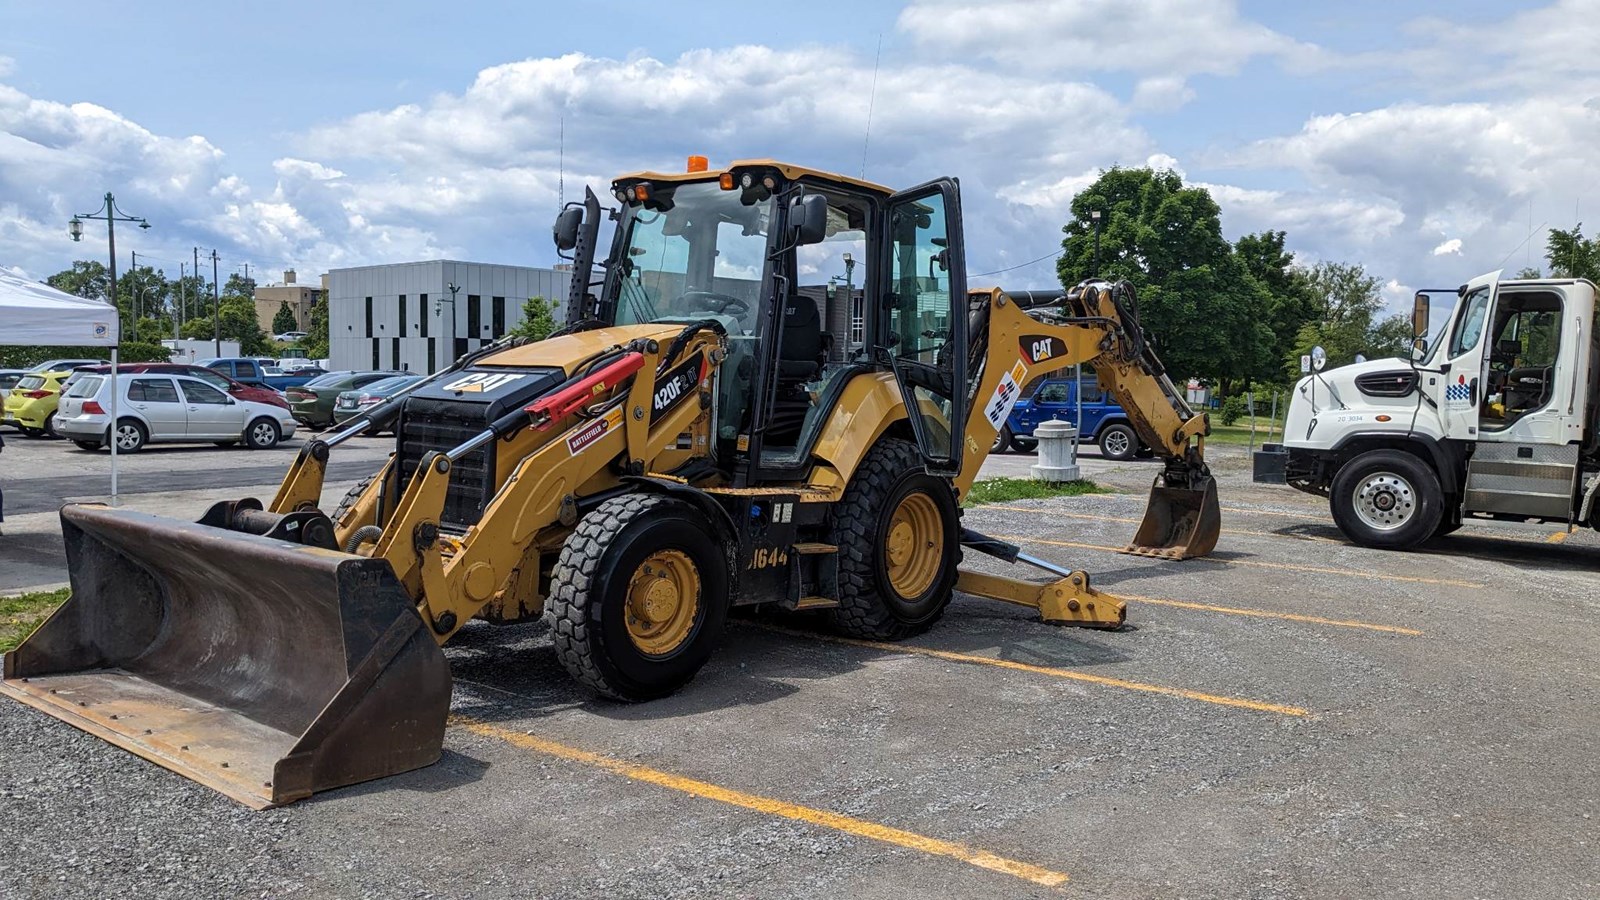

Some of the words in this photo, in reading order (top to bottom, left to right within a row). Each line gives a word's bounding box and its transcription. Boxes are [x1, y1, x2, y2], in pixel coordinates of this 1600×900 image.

[1032, 338, 1052, 362] CAT
[442, 373, 527, 393] CAT
[571, 425, 602, 449] BATTLEFIELD
